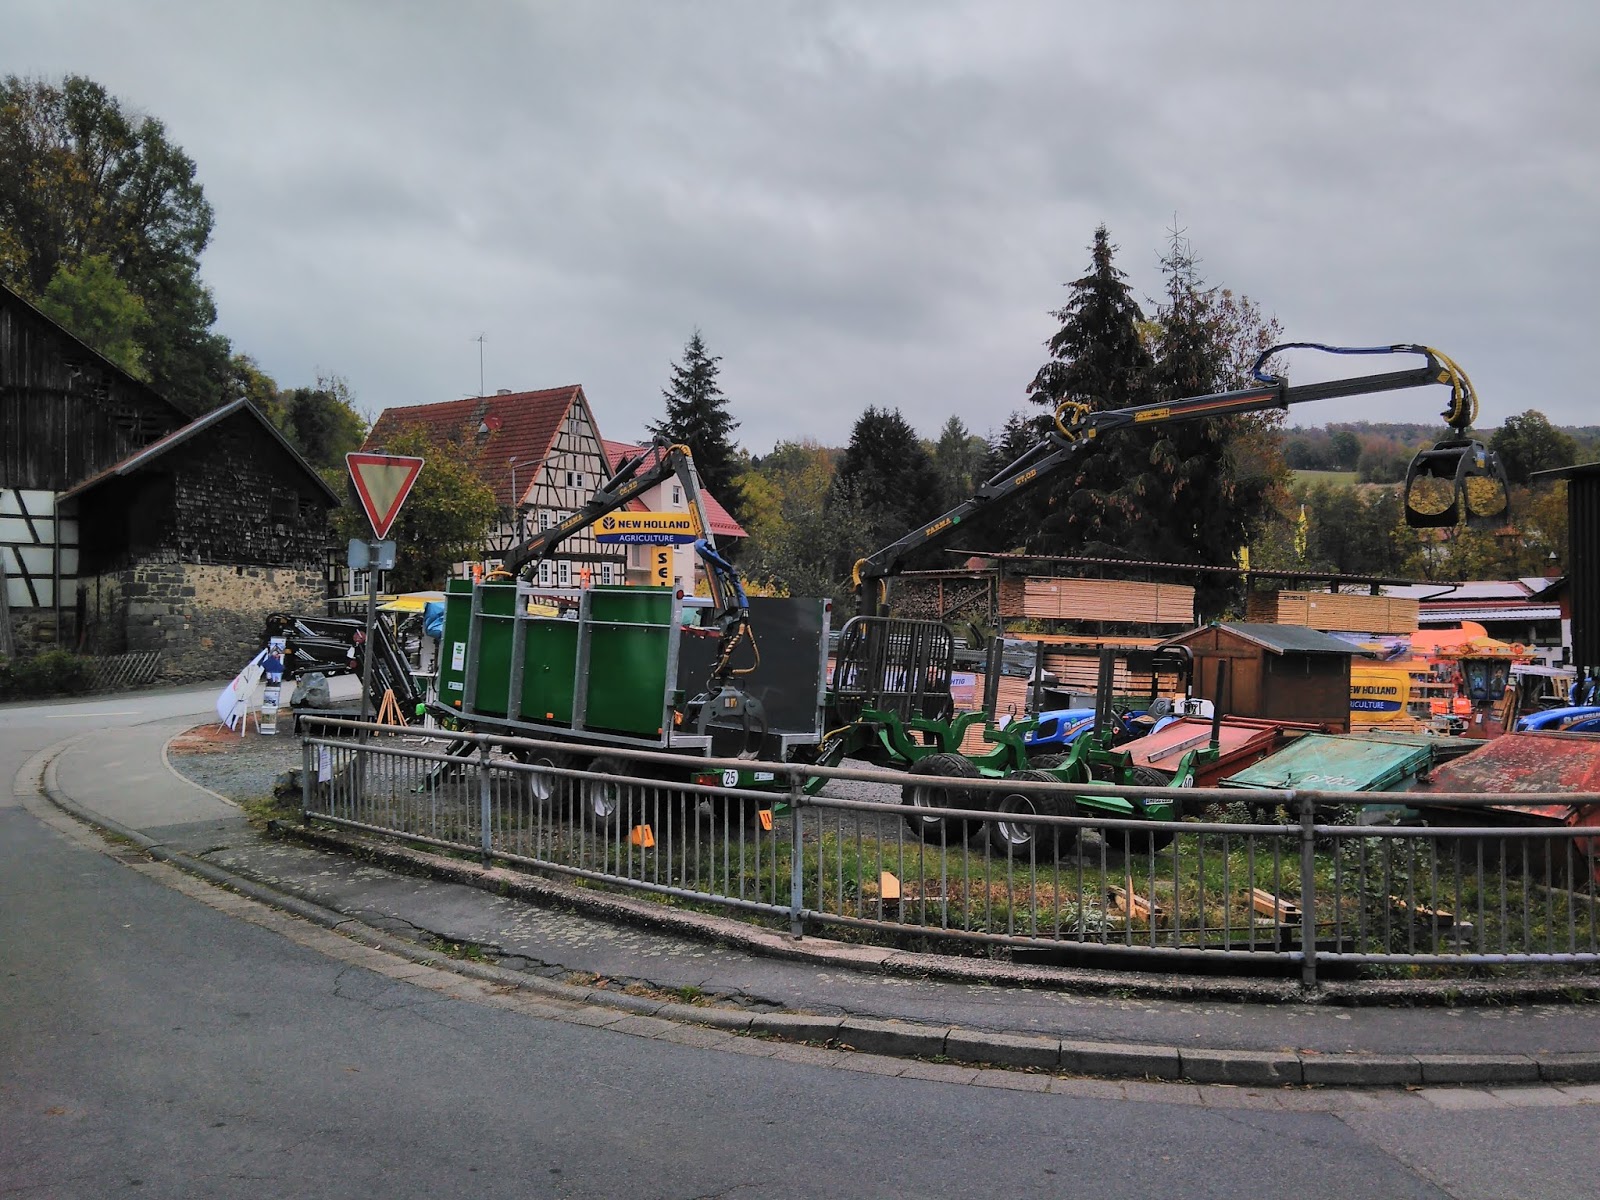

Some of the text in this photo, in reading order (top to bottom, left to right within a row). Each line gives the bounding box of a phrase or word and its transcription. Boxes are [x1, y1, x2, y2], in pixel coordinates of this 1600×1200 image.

[618, 520, 690, 529] NEW HOLLAND
[925, 518, 952, 536] FARMA
[1350, 686, 1396, 695] EW HOLLAND
[1350, 701, 1384, 709] RICULTURE
[725, 772, 735, 785] 25
